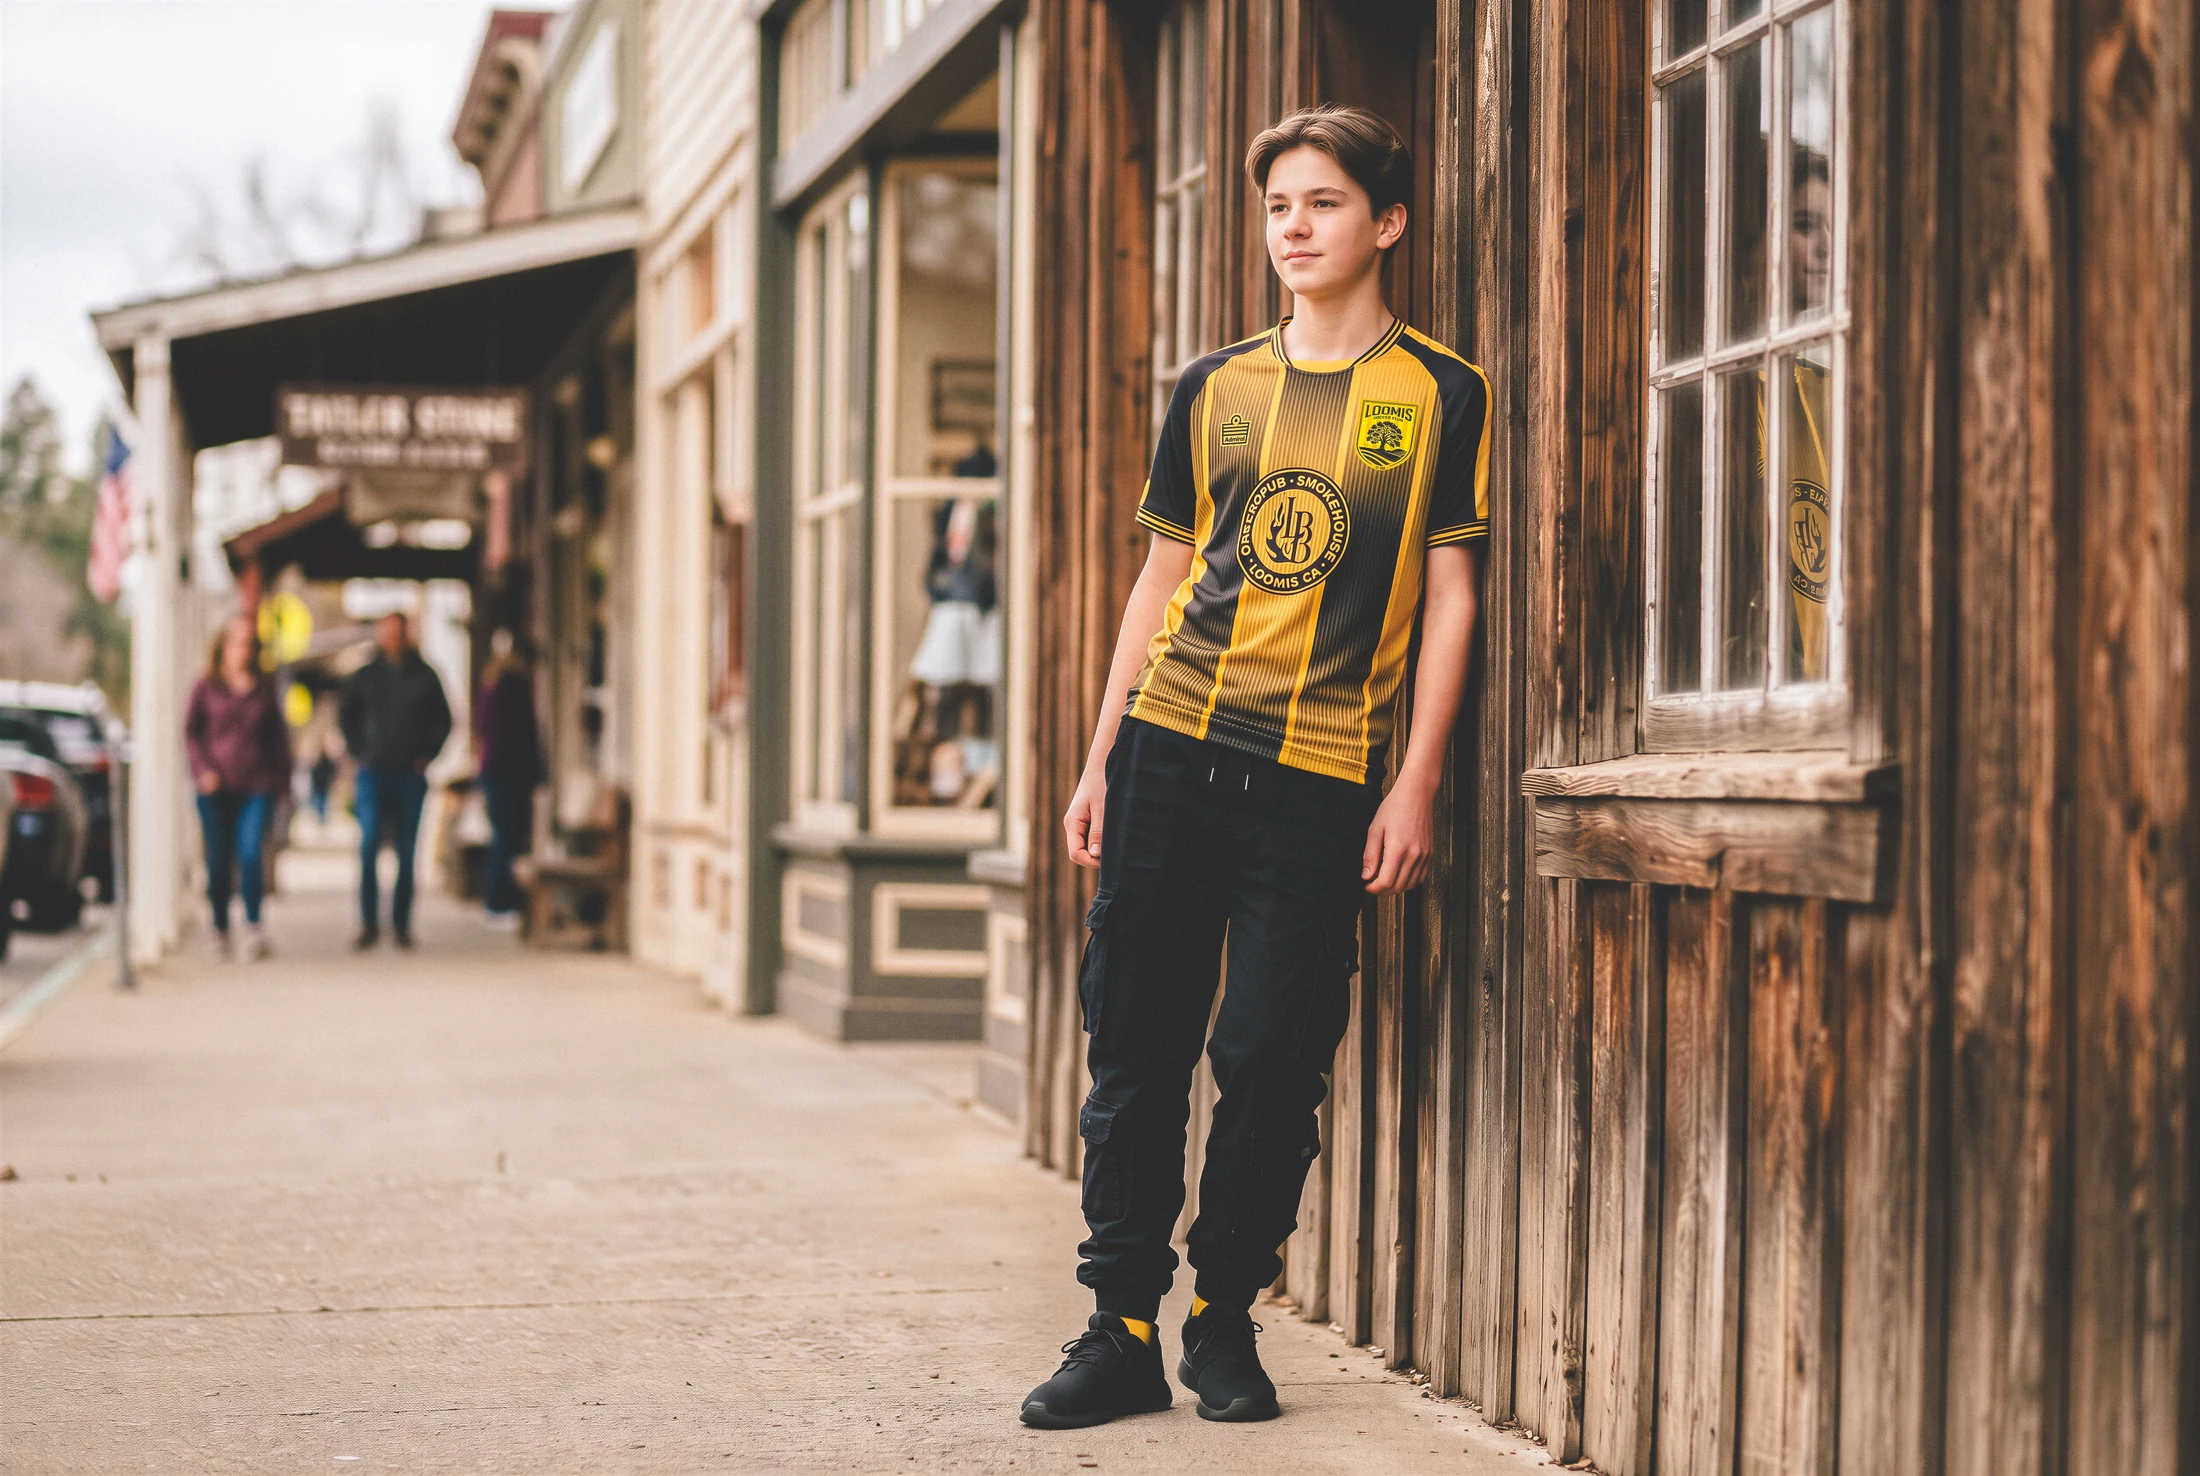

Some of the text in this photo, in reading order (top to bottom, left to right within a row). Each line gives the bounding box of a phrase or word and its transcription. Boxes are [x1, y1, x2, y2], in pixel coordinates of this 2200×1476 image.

[1365, 404, 1414, 422] LOOMIS
[1296, 475, 1345, 563] SMOKEHOUSE
[1248, 563, 1322, 589] LOOMIS CA
